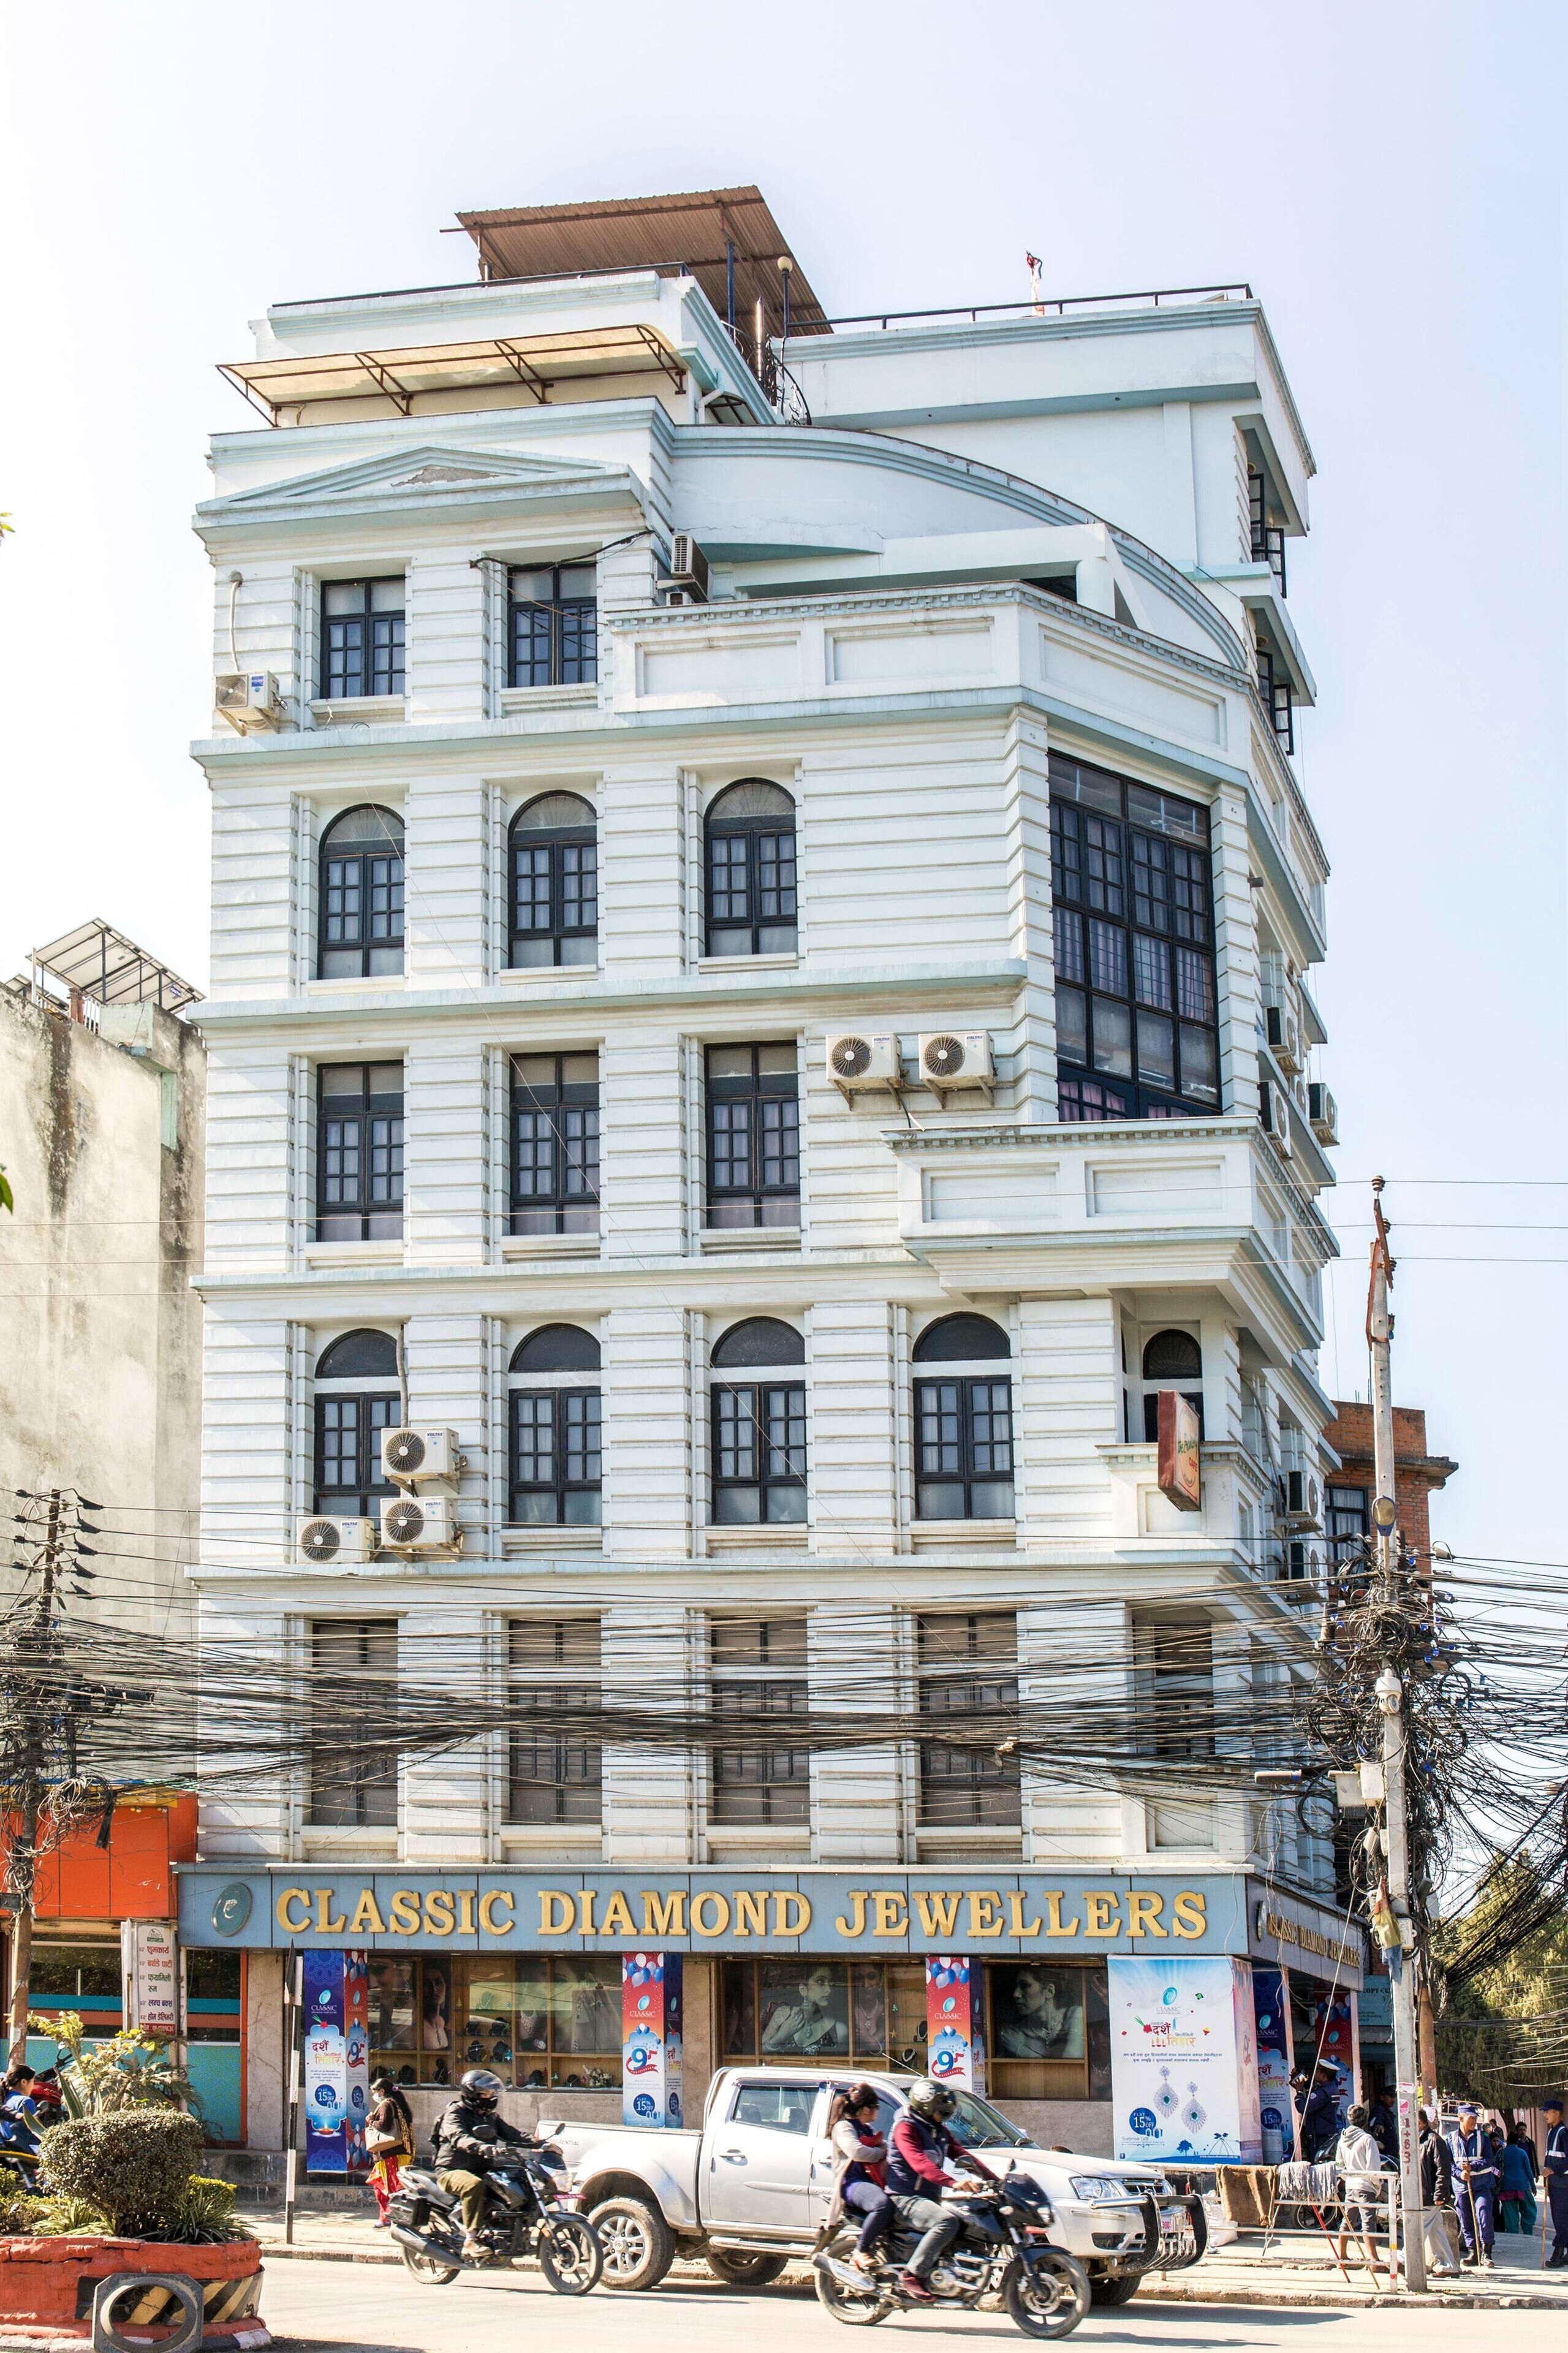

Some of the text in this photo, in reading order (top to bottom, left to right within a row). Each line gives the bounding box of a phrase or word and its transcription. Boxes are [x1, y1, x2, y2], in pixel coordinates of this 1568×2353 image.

[275, 1889, 1208, 1939] CLASSIC DIAMOND JEWELLERS
[1268, 1912, 1360, 1968] CLASSIC DIAMOND JEWELLERS
[1152, 2022, 1171, 2036] दशैं
[312, 2039, 329, 2052] दशैं
[1167, 2034, 1196, 2047] तिहार
[1134, 2116, 1151, 2128] 15%
